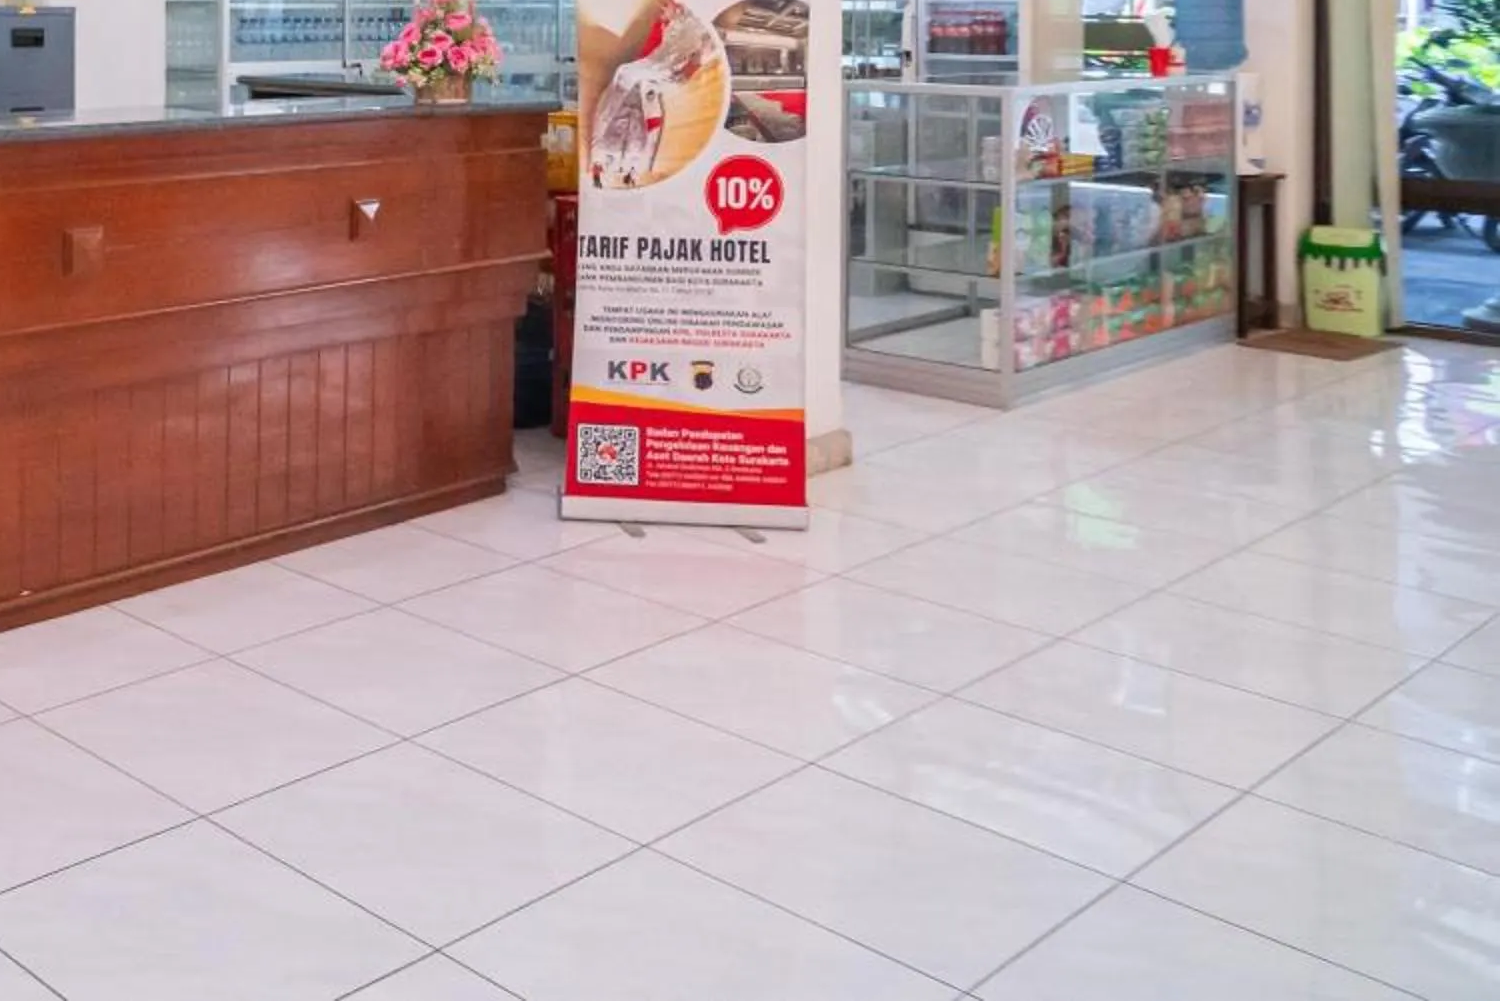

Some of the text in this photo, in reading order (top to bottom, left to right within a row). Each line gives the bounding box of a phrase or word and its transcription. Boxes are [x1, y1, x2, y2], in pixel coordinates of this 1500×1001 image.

[716, 176, 775, 211] 10%
[579, 235, 771, 264] TARIF PAJAK HOTEL
[607, 360, 670, 382] KPK
[645, 426, 679, 438] Badan
[646, 450, 789, 466] Aset Daerah Kota Surakarta
[767, 444, 787, 454] dan
